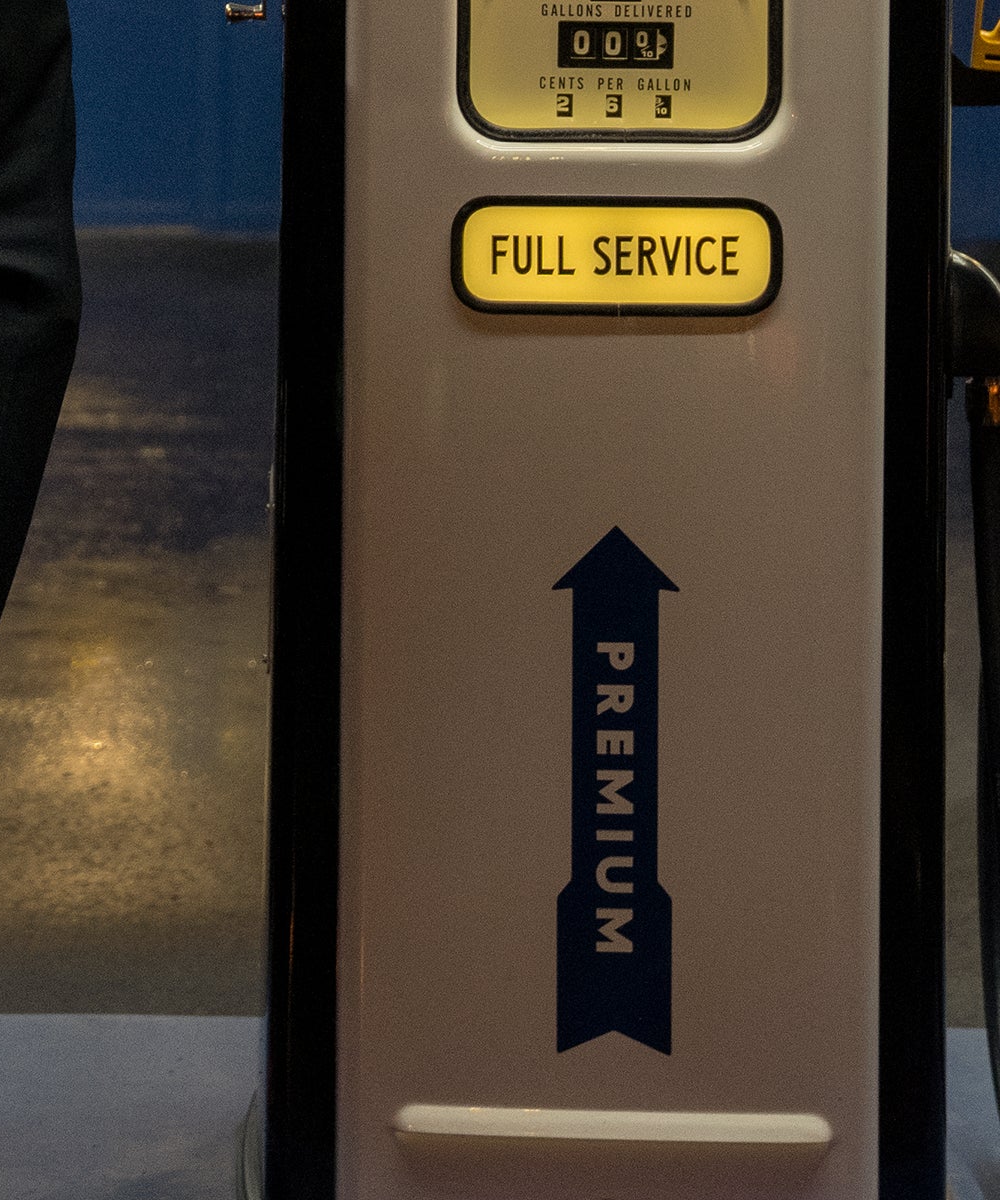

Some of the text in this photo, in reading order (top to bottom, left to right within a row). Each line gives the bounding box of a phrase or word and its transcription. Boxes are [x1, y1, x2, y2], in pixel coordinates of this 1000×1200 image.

[541, 3, 693, 18] GALLONS DELIVERED
[539, 75, 692, 92] CENTS PER GALLON
[556, 95, 570, 113] 2
[606, 96, 619, 114] 6
[491, 234, 740, 277] FULL SERVICE
[595, 641, 635, 954] PREMIUM
